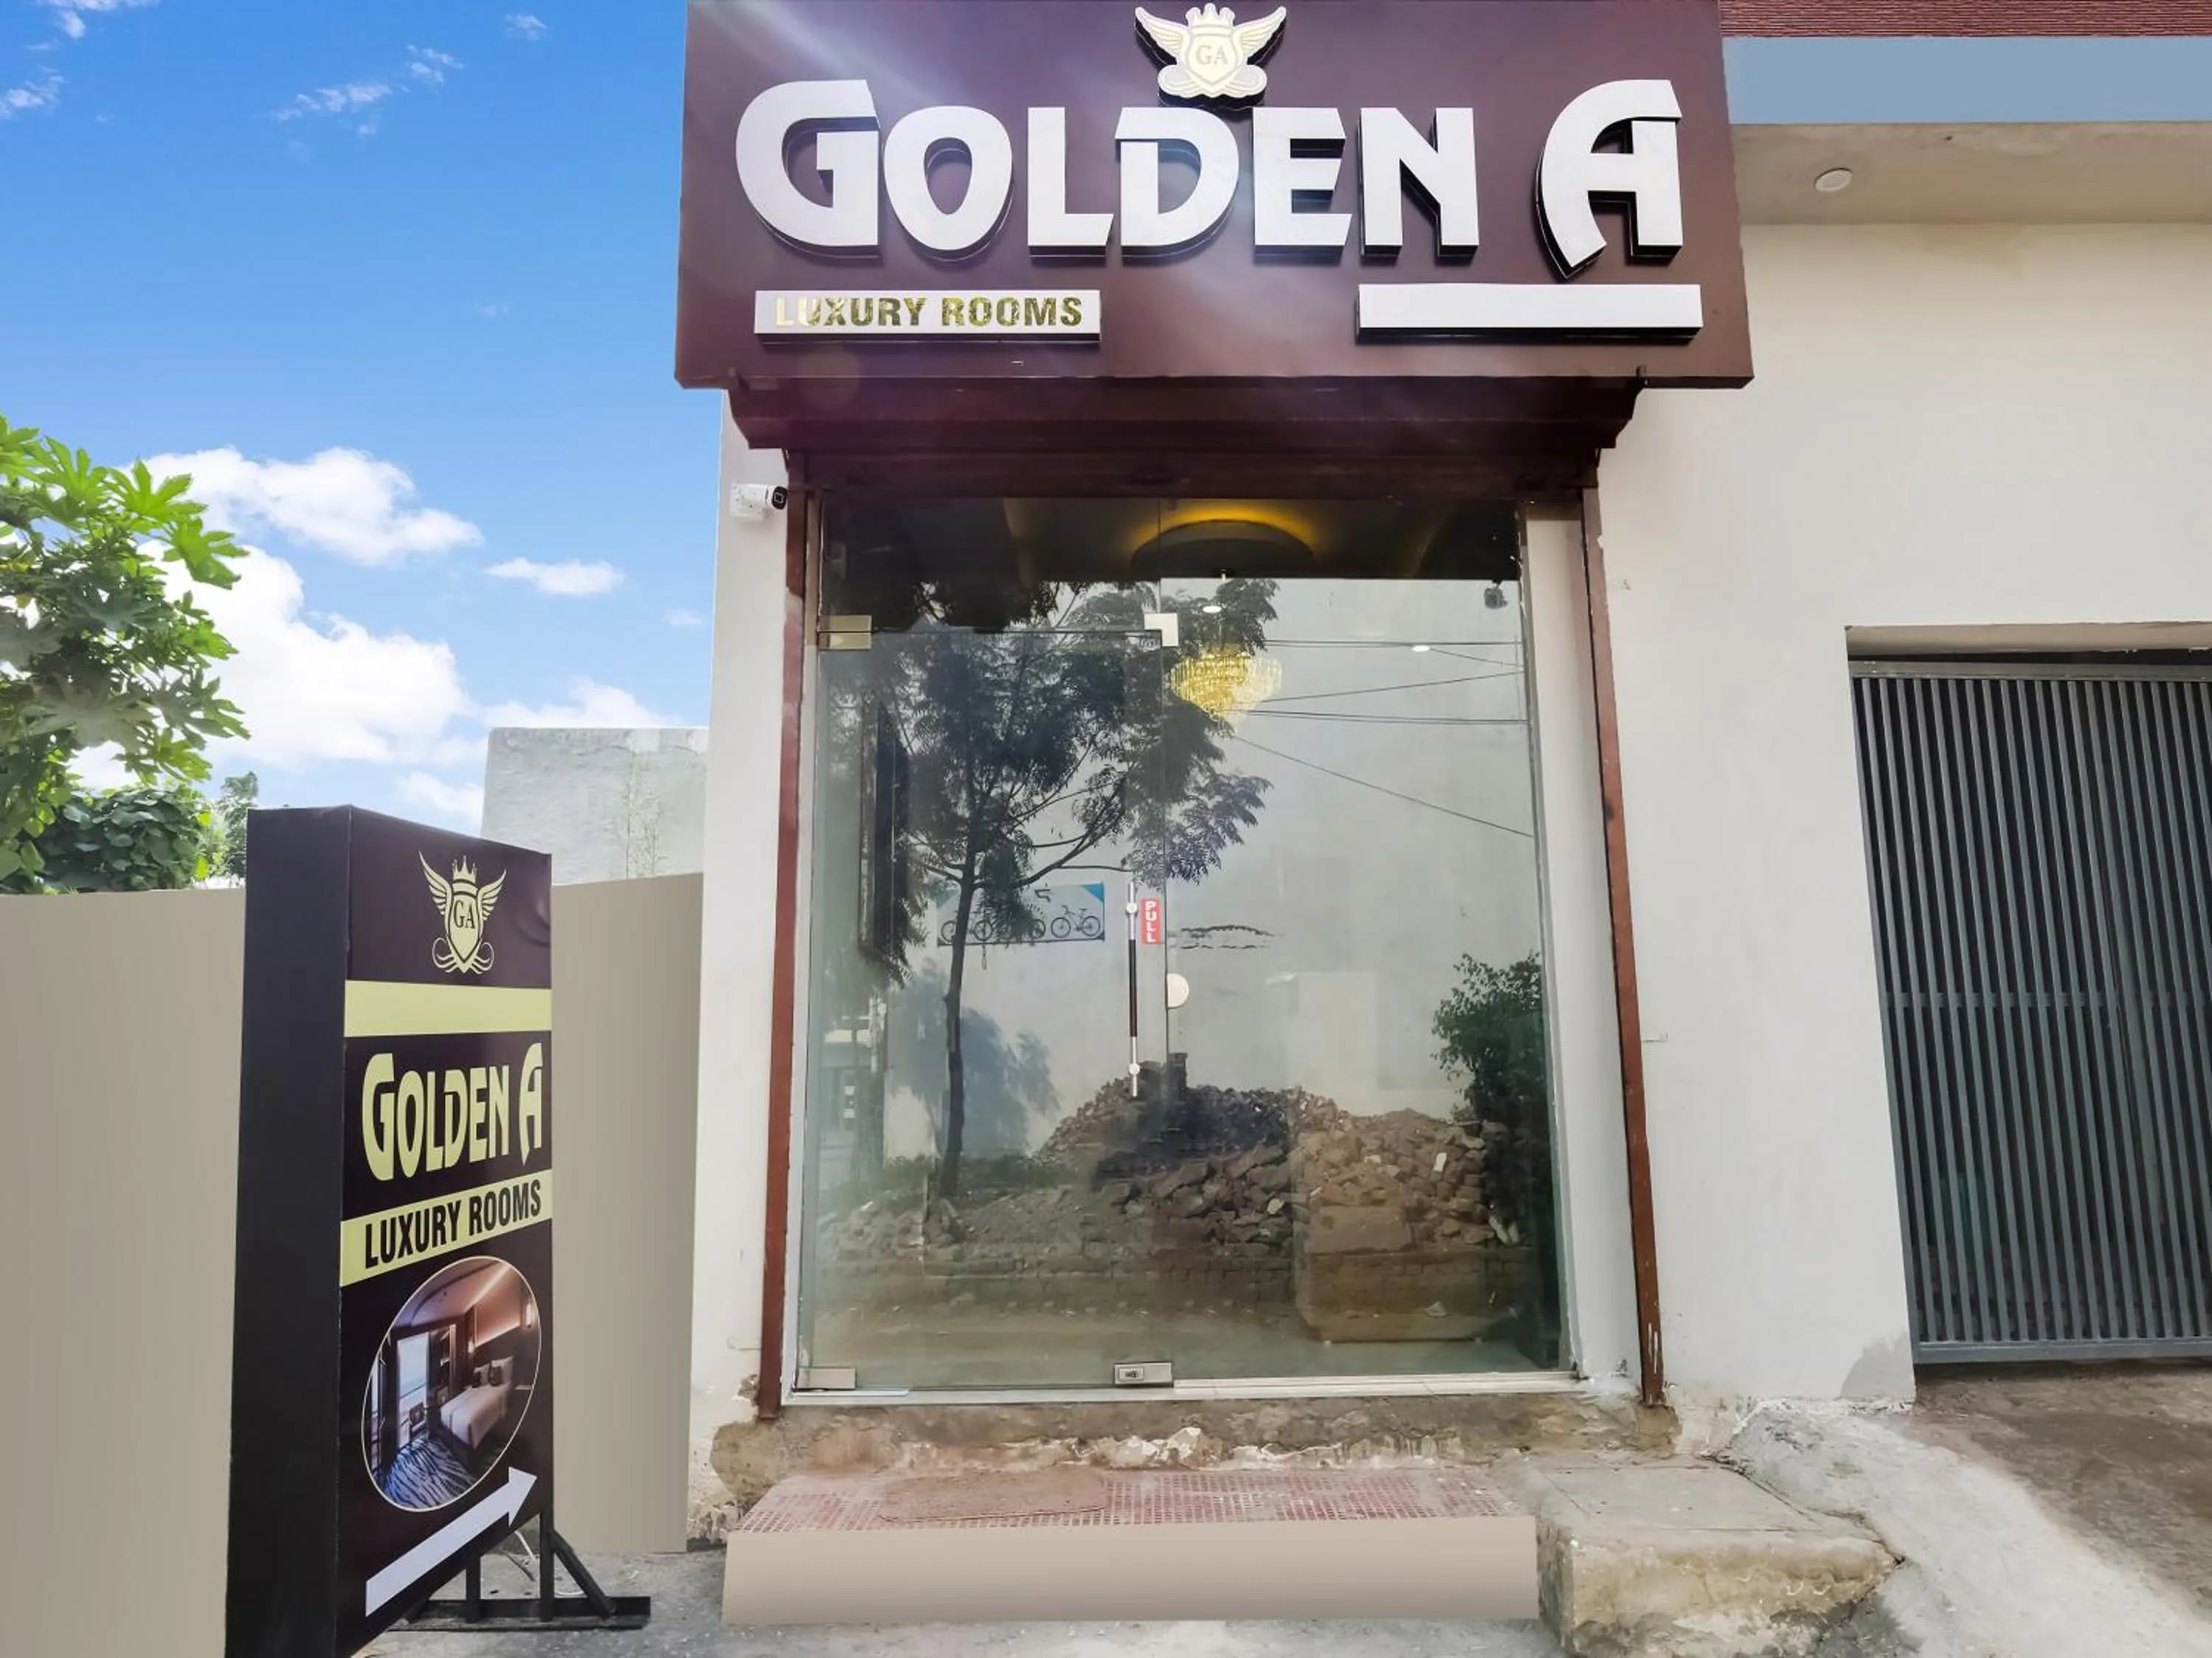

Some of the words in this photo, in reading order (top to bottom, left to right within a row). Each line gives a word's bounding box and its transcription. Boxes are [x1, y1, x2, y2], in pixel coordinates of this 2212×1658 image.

[1196, 45, 1228, 65] GA
[736, 79, 1479, 251] GOLDEN
[1540, 79, 1683, 267] A
[776, 297, 927, 327] LUXURY
[942, 297, 1082, 327] ROOMS
[453, 899, 476, 929] GA
[1144, 900, 1157, 943] PULL
[362, 1052, 509, 1182] GOLDEN
[518, 1042, 543, 1165] A
[365, 1200, 462, 1269] LUXURY
[468, 1179, 541, 1236] ROOMS
